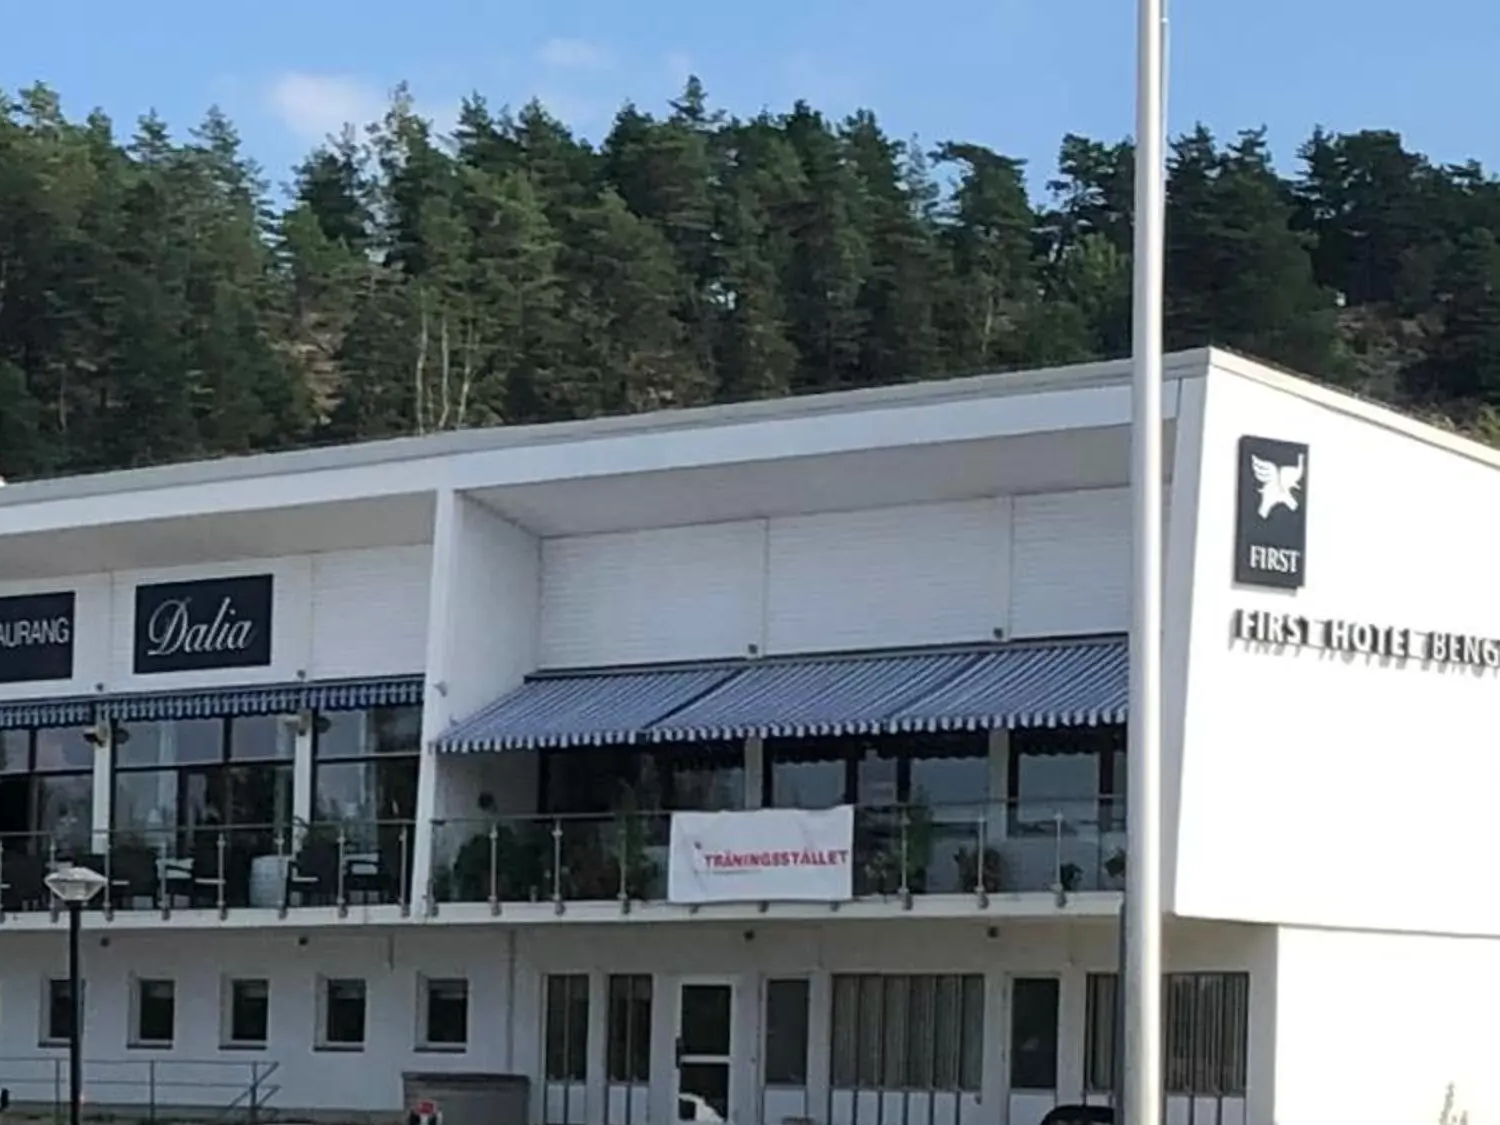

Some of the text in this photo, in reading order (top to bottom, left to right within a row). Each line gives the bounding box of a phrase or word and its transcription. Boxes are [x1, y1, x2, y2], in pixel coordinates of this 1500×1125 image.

[1250, 545, 1300, 573] FIRST
[147, 596, 254, 655] Dalia
[1234, 608, 1322, 651] FIRST
[1326, 619, 1423, 662] HOTEL
